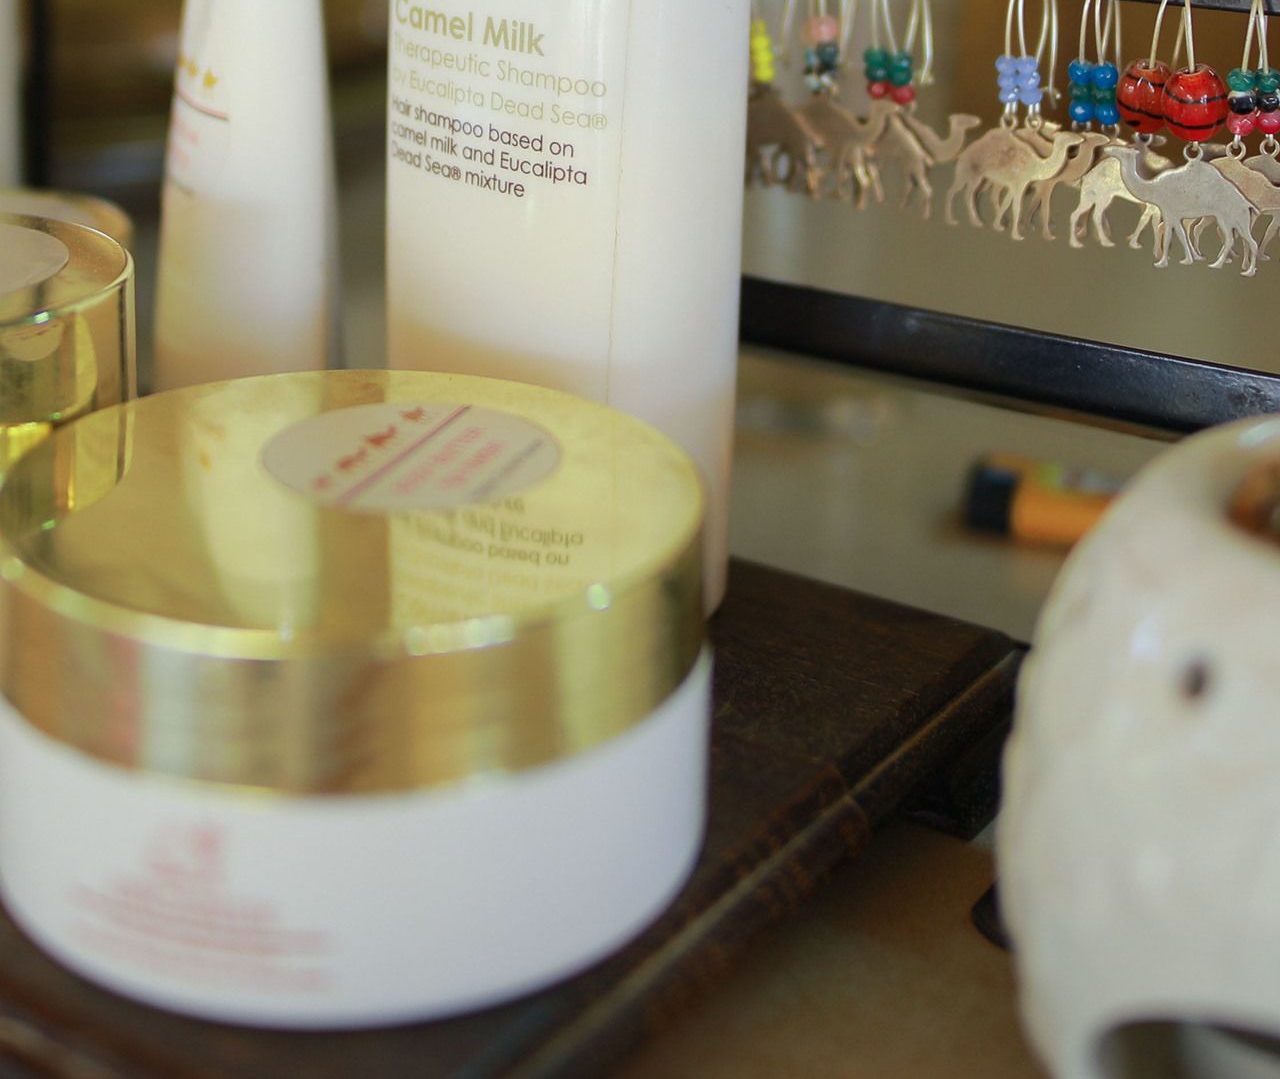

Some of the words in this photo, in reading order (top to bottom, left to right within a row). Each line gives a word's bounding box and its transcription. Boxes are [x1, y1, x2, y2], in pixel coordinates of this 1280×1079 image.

[482, 15, 546, 57] Milk
[394, 31, 490, 77] Therapeutic
[496, 59, 608, 98] Shampoo
[409, 69, 485, 107] Eucalipta
[490, 91, 544, 120] Dead
[391, 122, 427, 147] camel
[430, 136, 458, 157] milk
[462, 147, 495, 166] and
[500, 151, 588, 185] Eucalipta
[414, 104, 483, 138] shampoo
[488, 123, 543, 153] based
[549, 141, 574, 158] on
[391, 139, 422, 169] Dead
[465, 169, 525, 197] mixture
